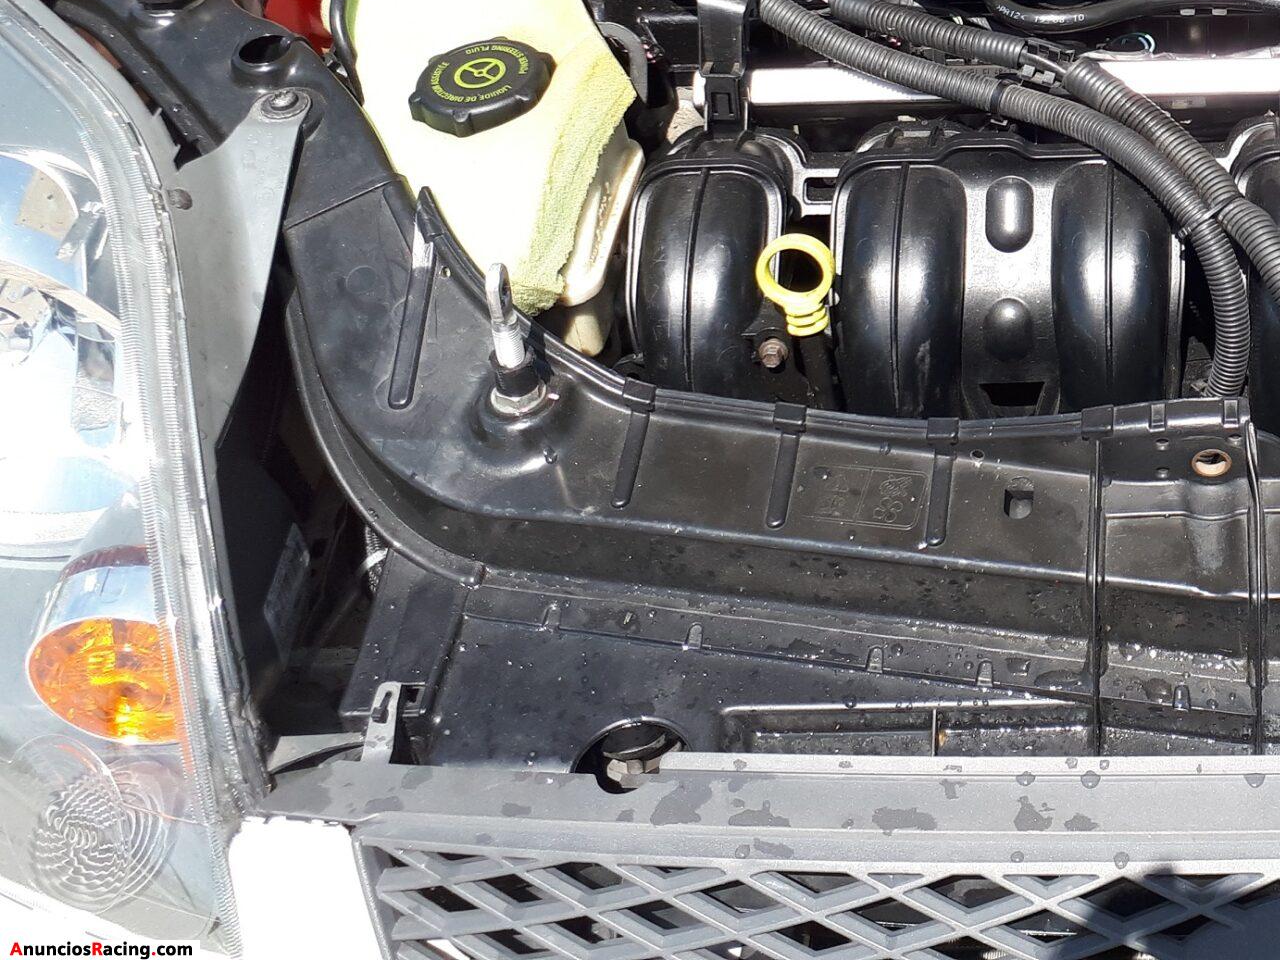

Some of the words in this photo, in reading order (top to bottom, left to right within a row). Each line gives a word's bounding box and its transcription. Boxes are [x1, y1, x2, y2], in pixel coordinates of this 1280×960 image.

[465, 45, 490, 55] FLUID
[491, 44, 524, 59] STEERING
[518, 58, 529, 74] POWER
[432, 84, 465, 103] DIRECTION
[479, 84, 513, 100] LIQUIDE
